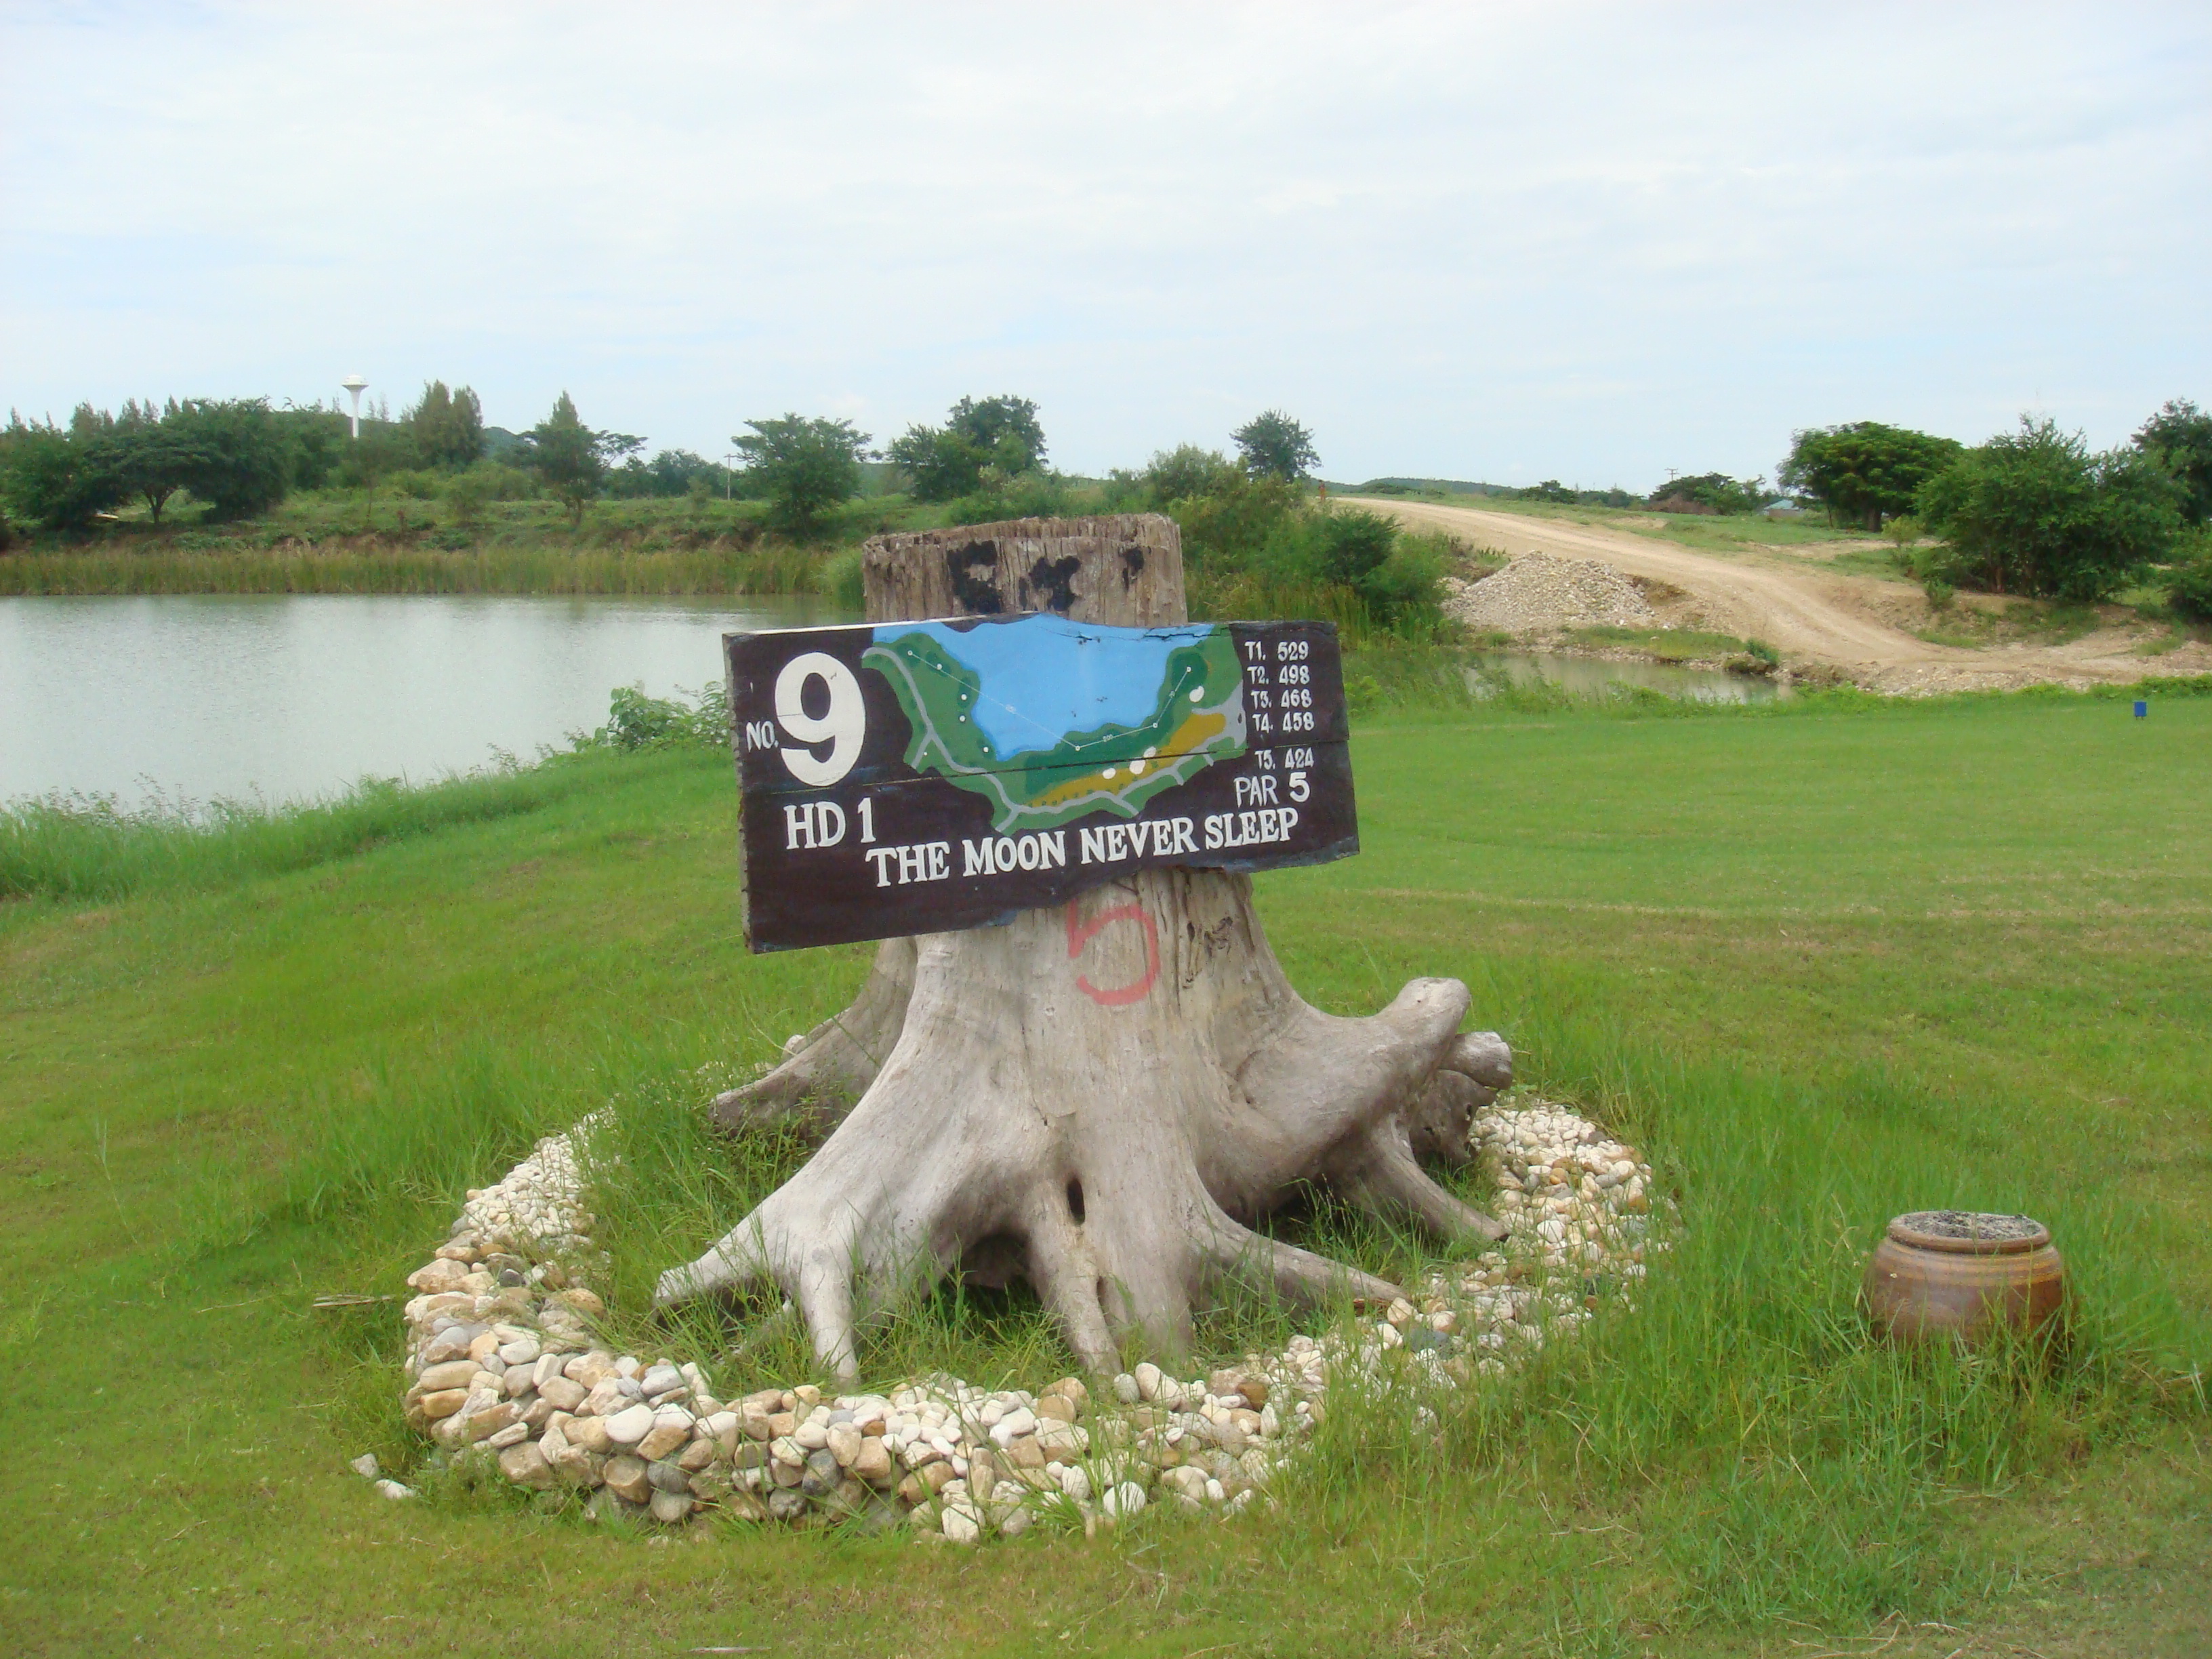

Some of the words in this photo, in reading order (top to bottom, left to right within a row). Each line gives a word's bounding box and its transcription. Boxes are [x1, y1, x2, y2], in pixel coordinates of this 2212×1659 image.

[1244, 640, 1267, 661] T1.
[1277, 640, 1309, 661] 529
[1247, 665, 1269, 685] T2.
[1278, 664, 1311, 686] 498
[1250, 690, 1273, 710] T3.
[1280, 688, 1313, 708] 468
[746, 720, 779, 752] NO.
[775, 651, 866, 787] 9
[1252, 712, 1273, 734] T4.
[1282, 711, 1315, 733] 458
[1254, 749, 1276, 771] T5.
[1285, 747, 1315, 770] 424
[1234, 775, 1280, 808] PAR
[1288, 771, 1311, 802] 5
[783, 800, 846, 850] HD
[857, 797, 877, 844] 1
[865, 841, 950, 888] THE
[961, 829, 1067, 878] MOON
[1079, 816, 1200, 865] NEVER
[1204, 806, 1299, 849] SLEEP
